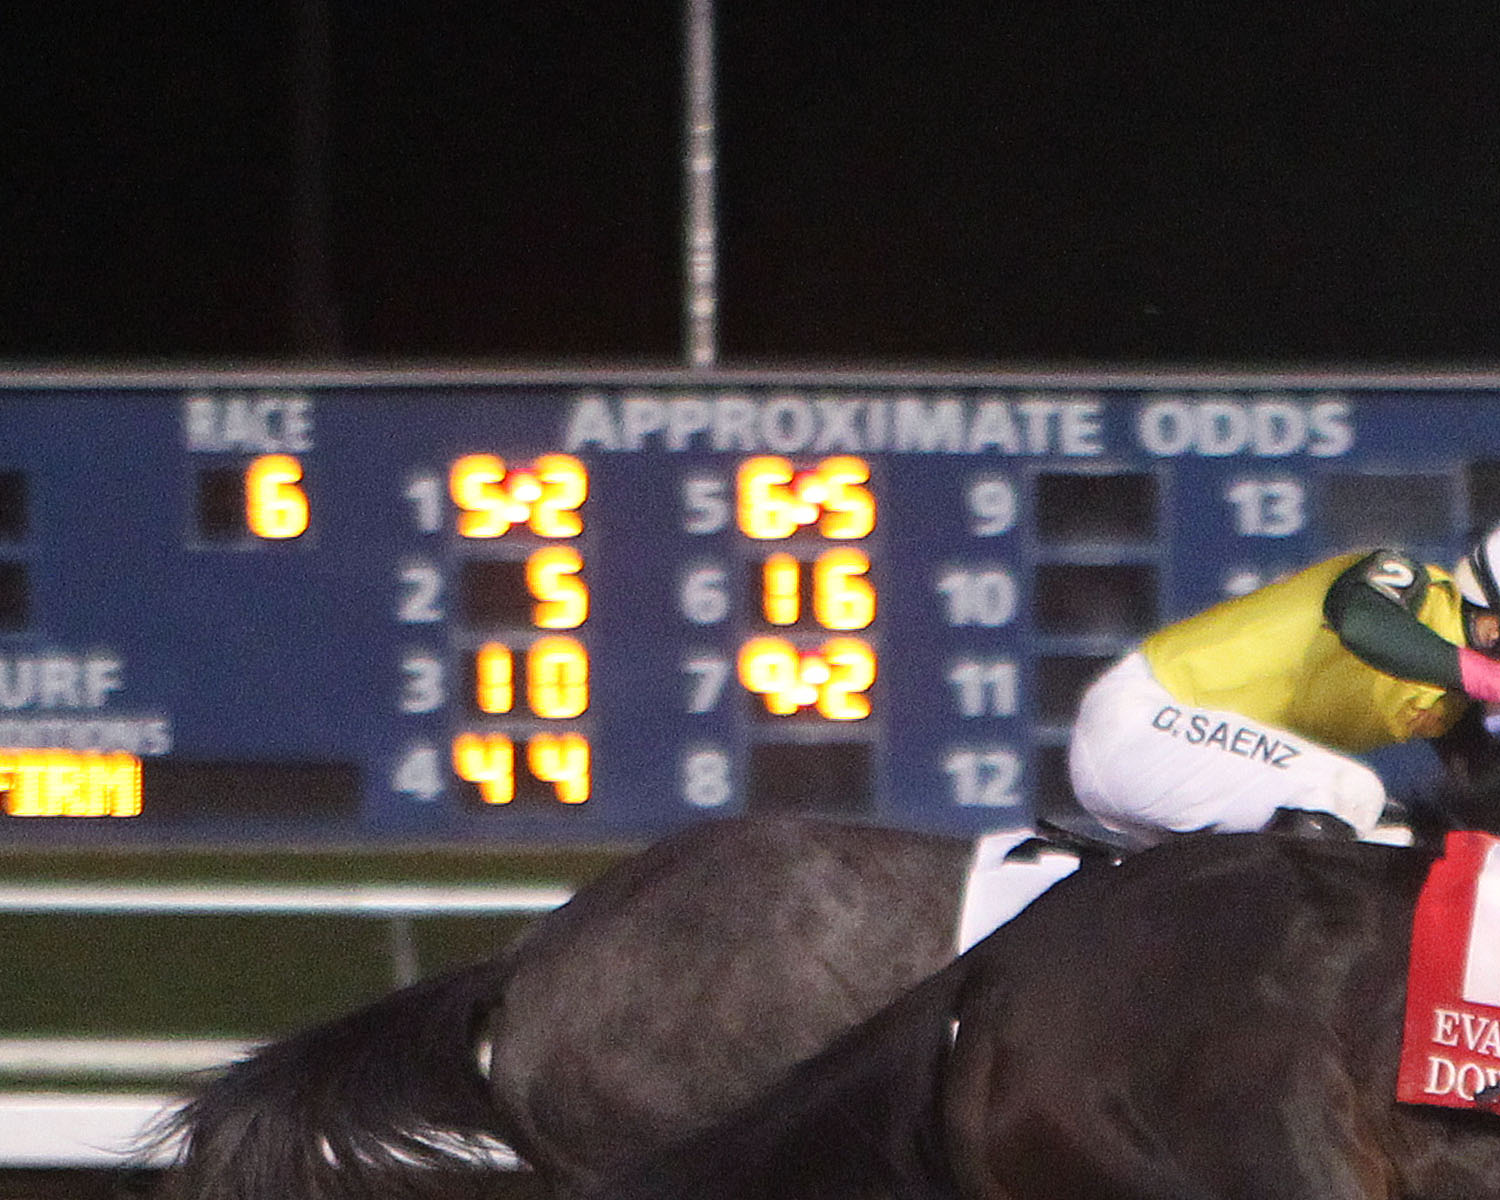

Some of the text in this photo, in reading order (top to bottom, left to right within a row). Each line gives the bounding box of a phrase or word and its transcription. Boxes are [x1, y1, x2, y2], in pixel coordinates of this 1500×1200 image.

[186, 398, 314, 452] RACE
[566, 398, 1354, 457] APPROXIMATE ODDS
[245, 453, 311, 538] 6
[407, 477, 442, 533] 1
[682, 480, 729, 535] 5
[965, 479, 1016, 537] 9
[1225, 480, 1306, 536] 13
[398, 567, 443, 623] 2
[526, 545, 590, 629] 5
[681, 569, 731, 626] 6
[762, 548, 877, 631] 16
[938, 569, 1017, 627] 10
[400, 658, 443, 713] 3
[477, 635, 590, 719] 10
[684, 658, 732, 714] 7
[950, 661, 1018, 718] 11
[393, 744, 443, 800] 4
[453, 732, 591, 805] 44
[683, 749, 732, 807] 8
[944, 751, 1021, 807] 12
